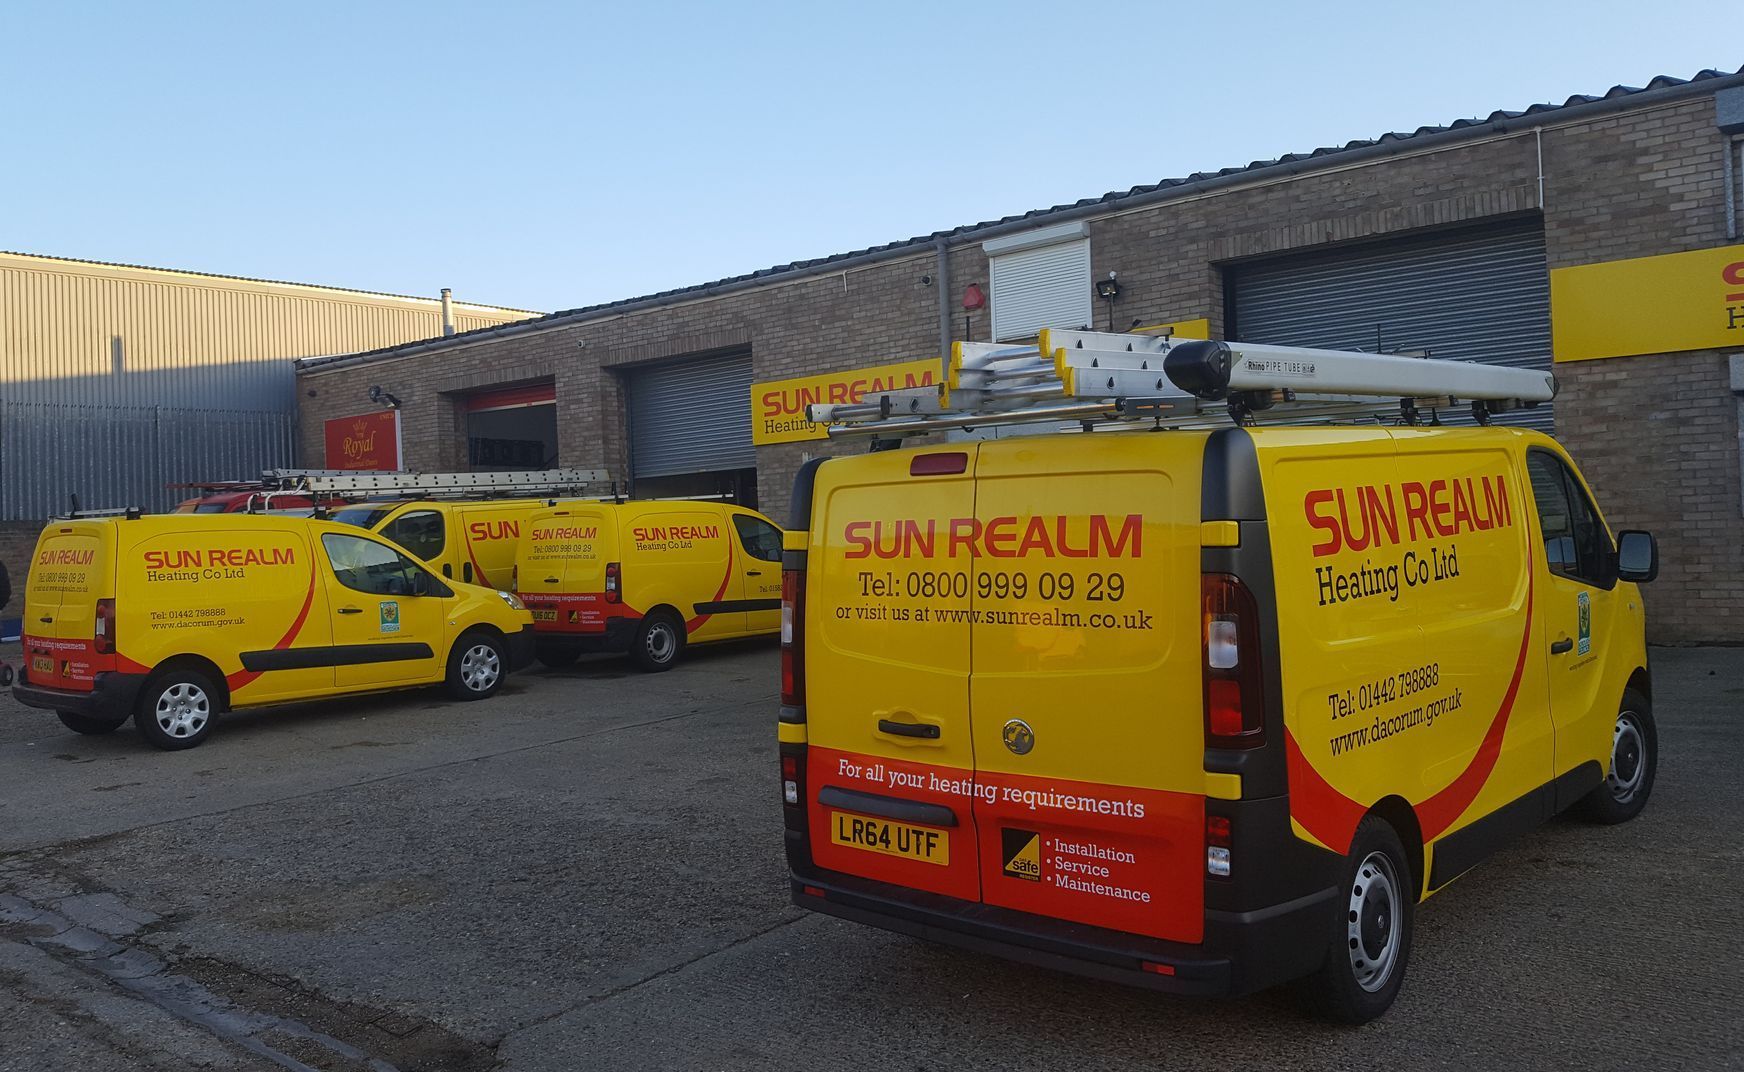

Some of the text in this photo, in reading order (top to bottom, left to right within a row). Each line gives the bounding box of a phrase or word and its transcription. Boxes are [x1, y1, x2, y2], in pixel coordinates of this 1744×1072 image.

[1248, 361, 1265, 371] Rhino
[1266, 361, 1281, 371] PIPE
[1284, 362, 1300, 373] TUBE
[765, 416, 817, 434] Heating
[343, 430, 377, 460] Royal
[1305, 475, 1512, 557] SUN REALM
[470, 520, 520, 542] SUN
[531, 527, 597, 540] SUN REALM
[633, 526, 719, 541] SUN REALM
[844, 514, 1143, 559] SUN REALM
[636, 541, 692, 551] Heating Co Ltd
[39, 549, 94, 566] SUN REALM
[144, 548, 295, 569] SUN REALM
[147, 567, 245, 583] Heating Co Ltd
[1315, 544, 1460, 606] Heating Co Ltd
[858, 572, 1125, 602] Tel: 0800 999 09 29
[151, 608, 226, 620] Tel: 01442 798888
[151, 617, 246, 630] www.dacorum.gov.uk
[836, 603, 1153, 630] or visit us at www.sunrealm.co.uk
[1328, 662, 1439, 720] Tel: 01442 798888
[1329, 687, 1462, 757] www.dacorum.gov.uk
[838, 759, 1145, 818] For all your heating requirements
[840, 816, 939, 857] LR64 UTF
[1055, 838, 1135, 864] Installation
[1012, 860, 1038, 874] safe
[1055, 857, 1109, 878] Service
[1055, 874, 1151, 903] Maintenance
